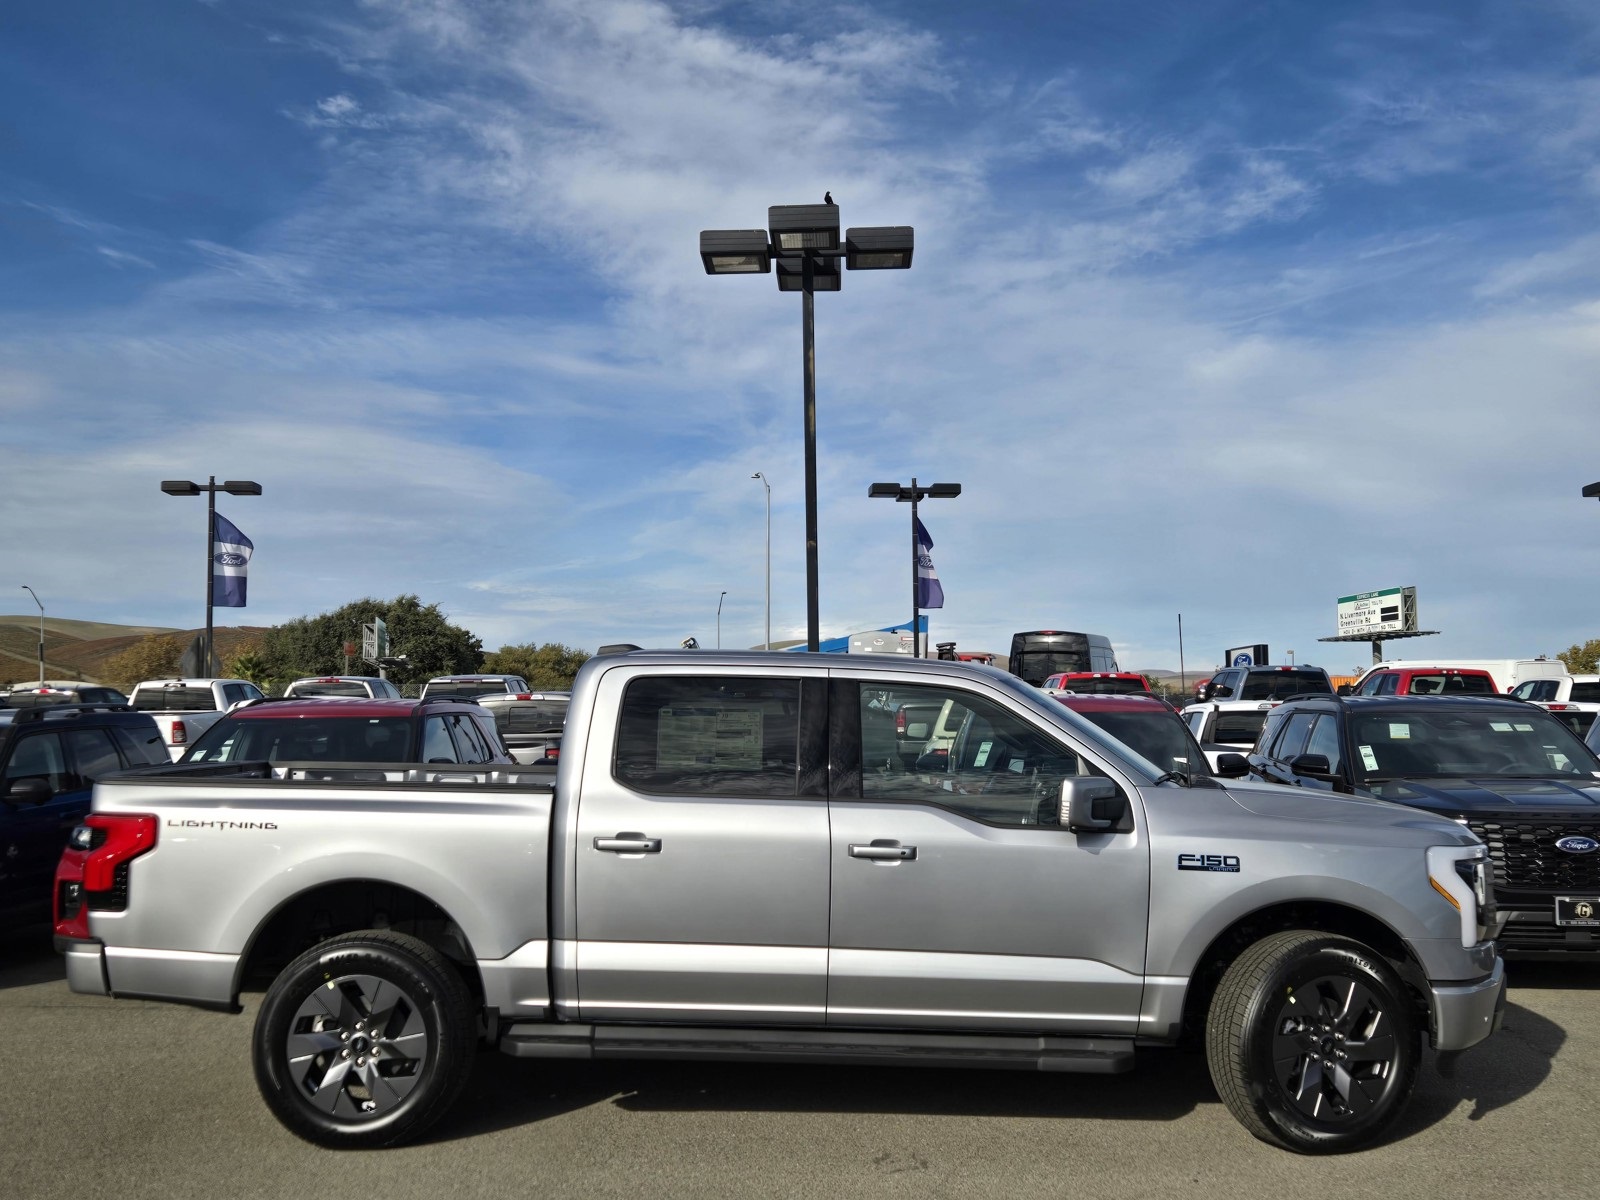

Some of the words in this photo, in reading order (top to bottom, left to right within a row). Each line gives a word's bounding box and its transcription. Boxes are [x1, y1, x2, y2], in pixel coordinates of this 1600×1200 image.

[221, 553, 242, 565] Ford
[1345, 610, 1366, 619] Livermore
[1340, 618, 1363, 627] Greenville
[167, 819, 279, 830] LIGHTNING
[1177, 854, 1240, 867] F-150
